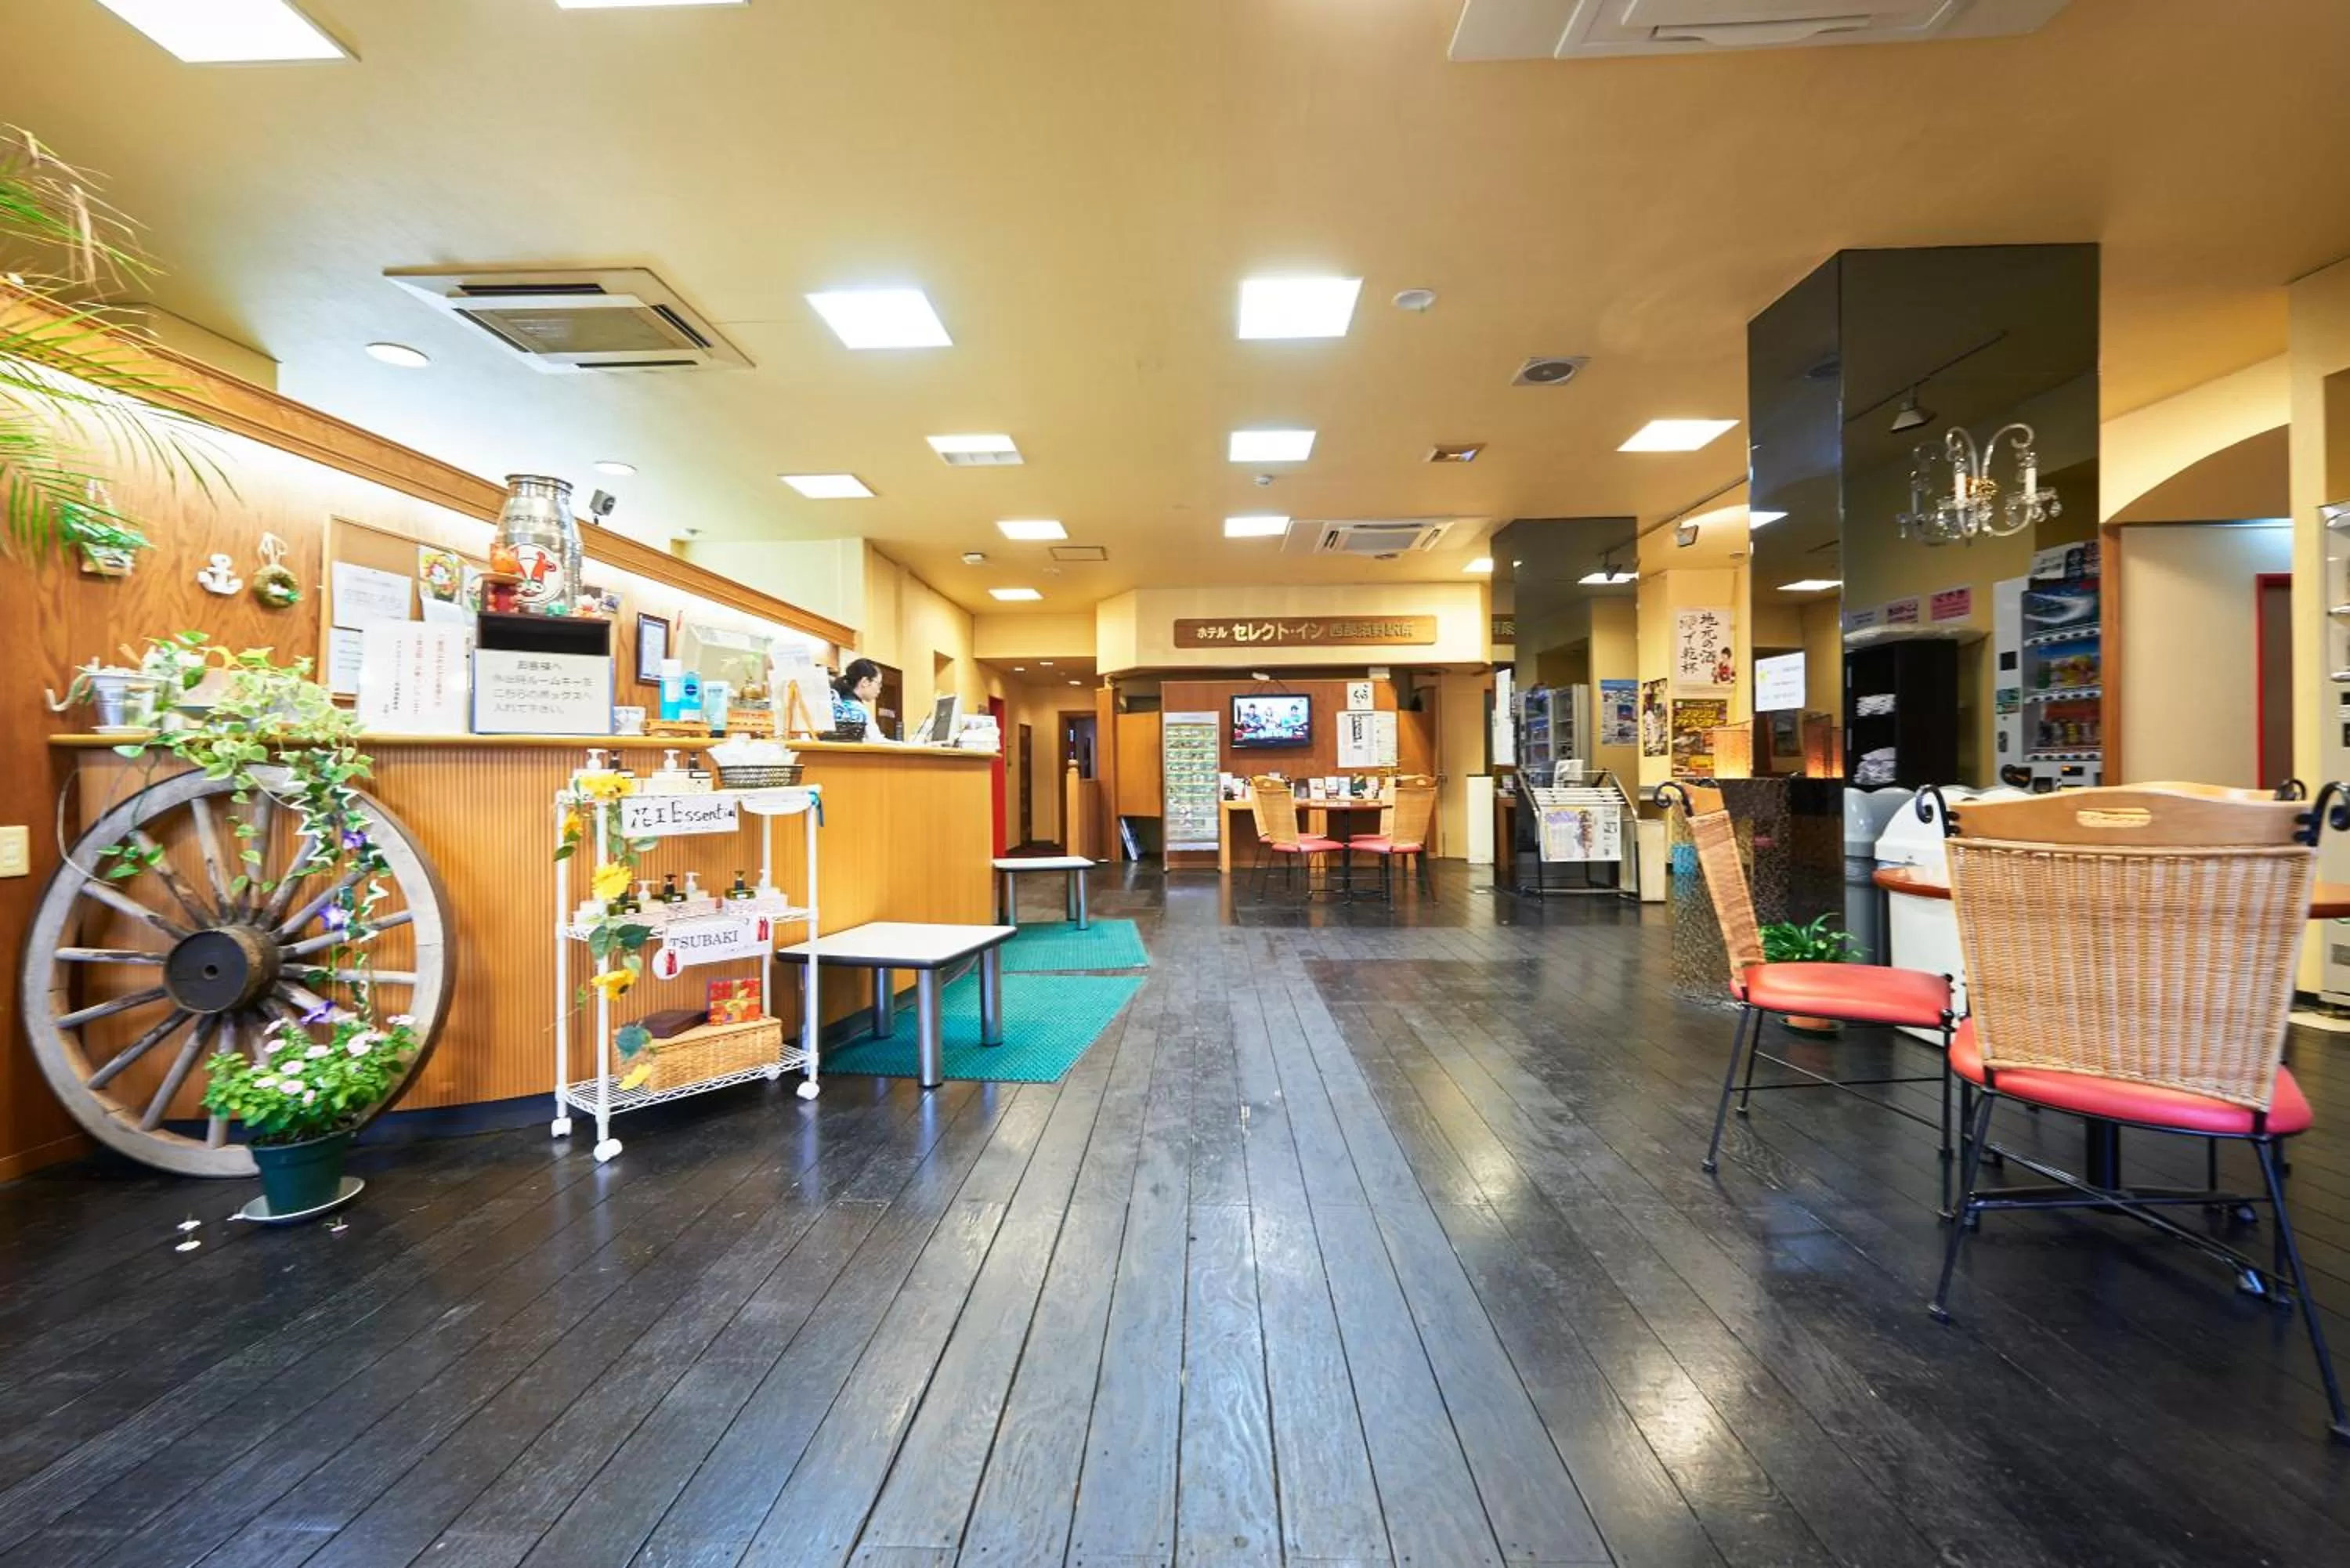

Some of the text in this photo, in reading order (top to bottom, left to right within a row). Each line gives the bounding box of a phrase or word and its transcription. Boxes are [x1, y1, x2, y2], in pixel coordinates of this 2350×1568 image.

[1196, 627, 1227, 638] ホテル
[670, 930, 739, 949] TSUBAKI
